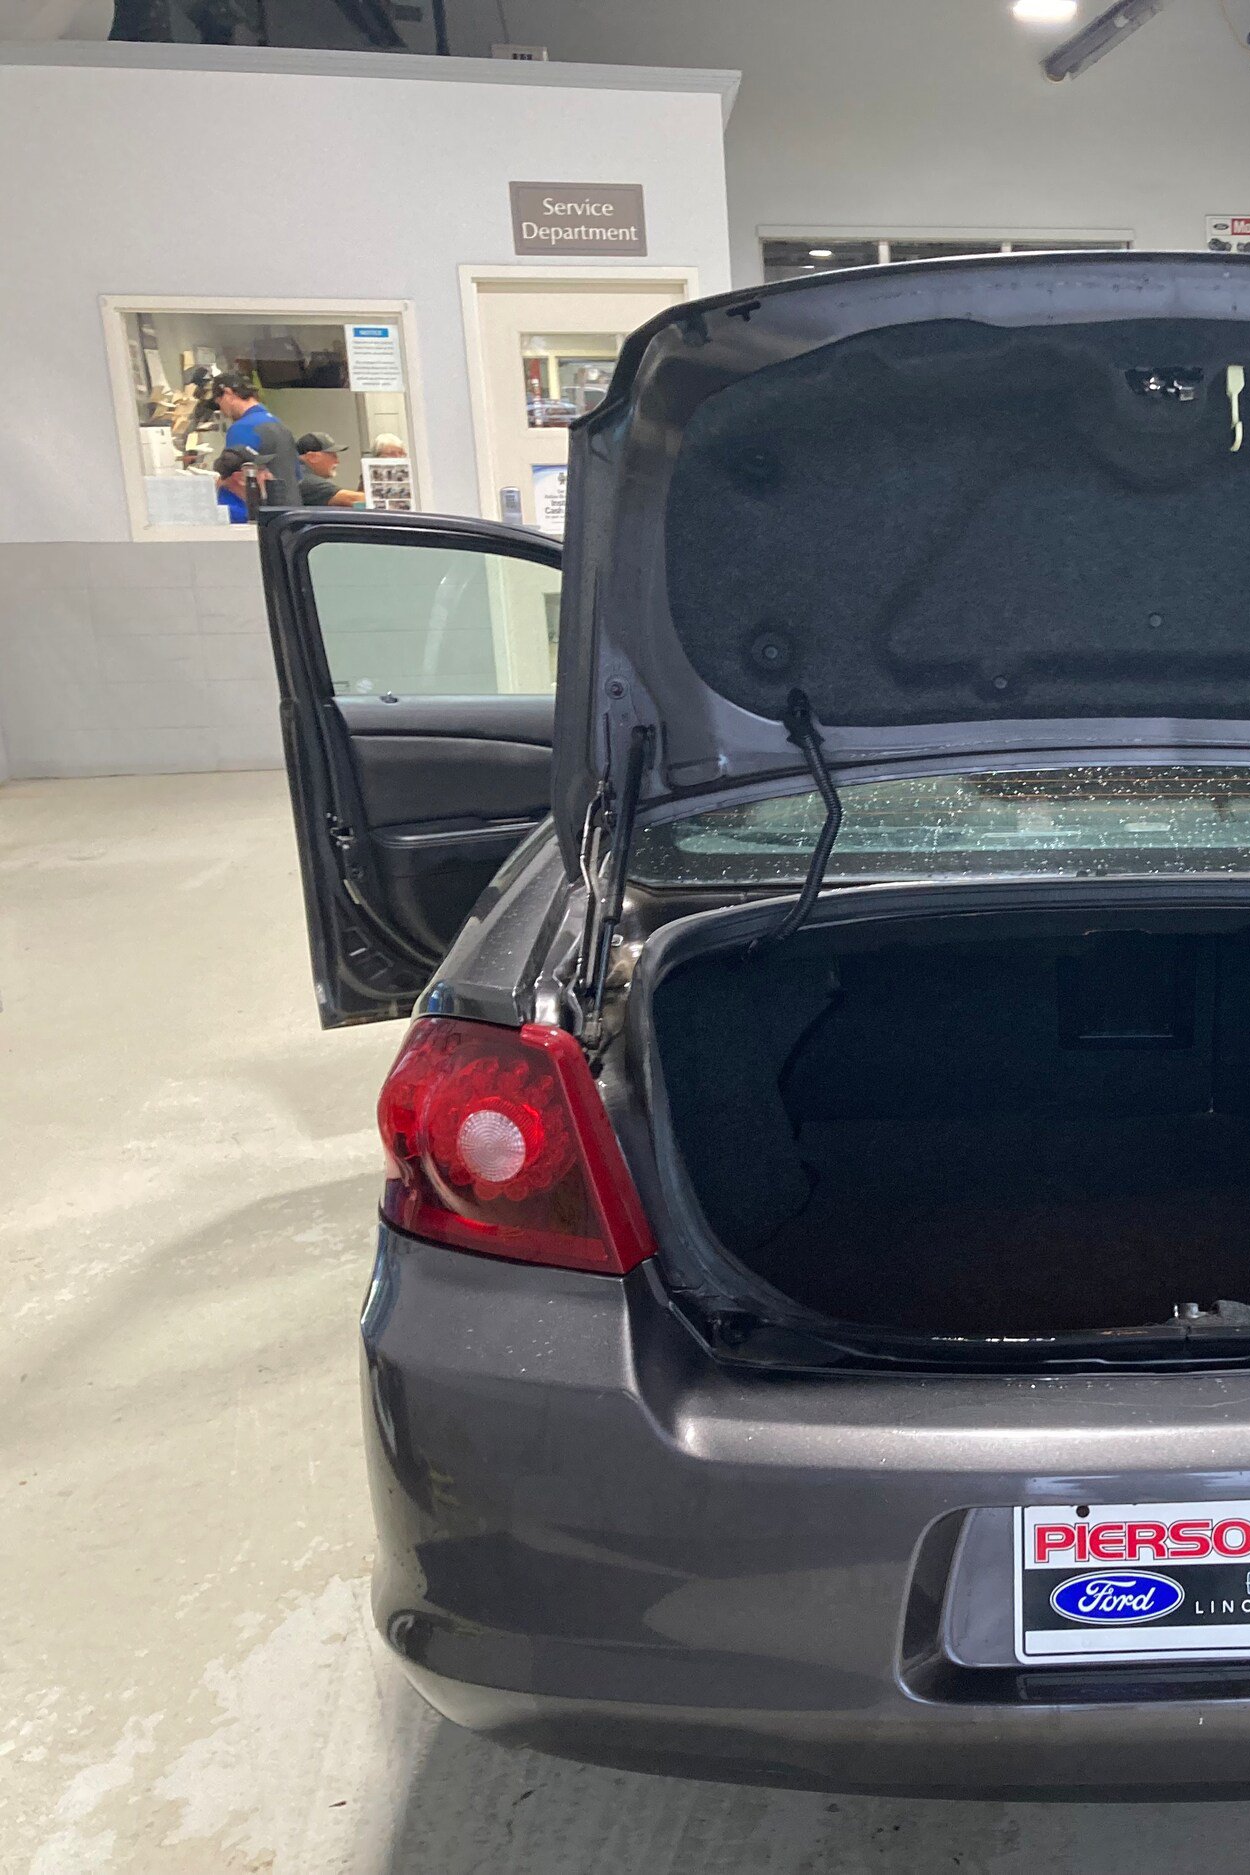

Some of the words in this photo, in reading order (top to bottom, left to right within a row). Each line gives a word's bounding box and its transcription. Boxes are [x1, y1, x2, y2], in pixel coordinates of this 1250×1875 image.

[543, 197, 614, 216] Service
[521, 222, 638, 245] Department
[1077, 1579, 1155, 1613] Ford
